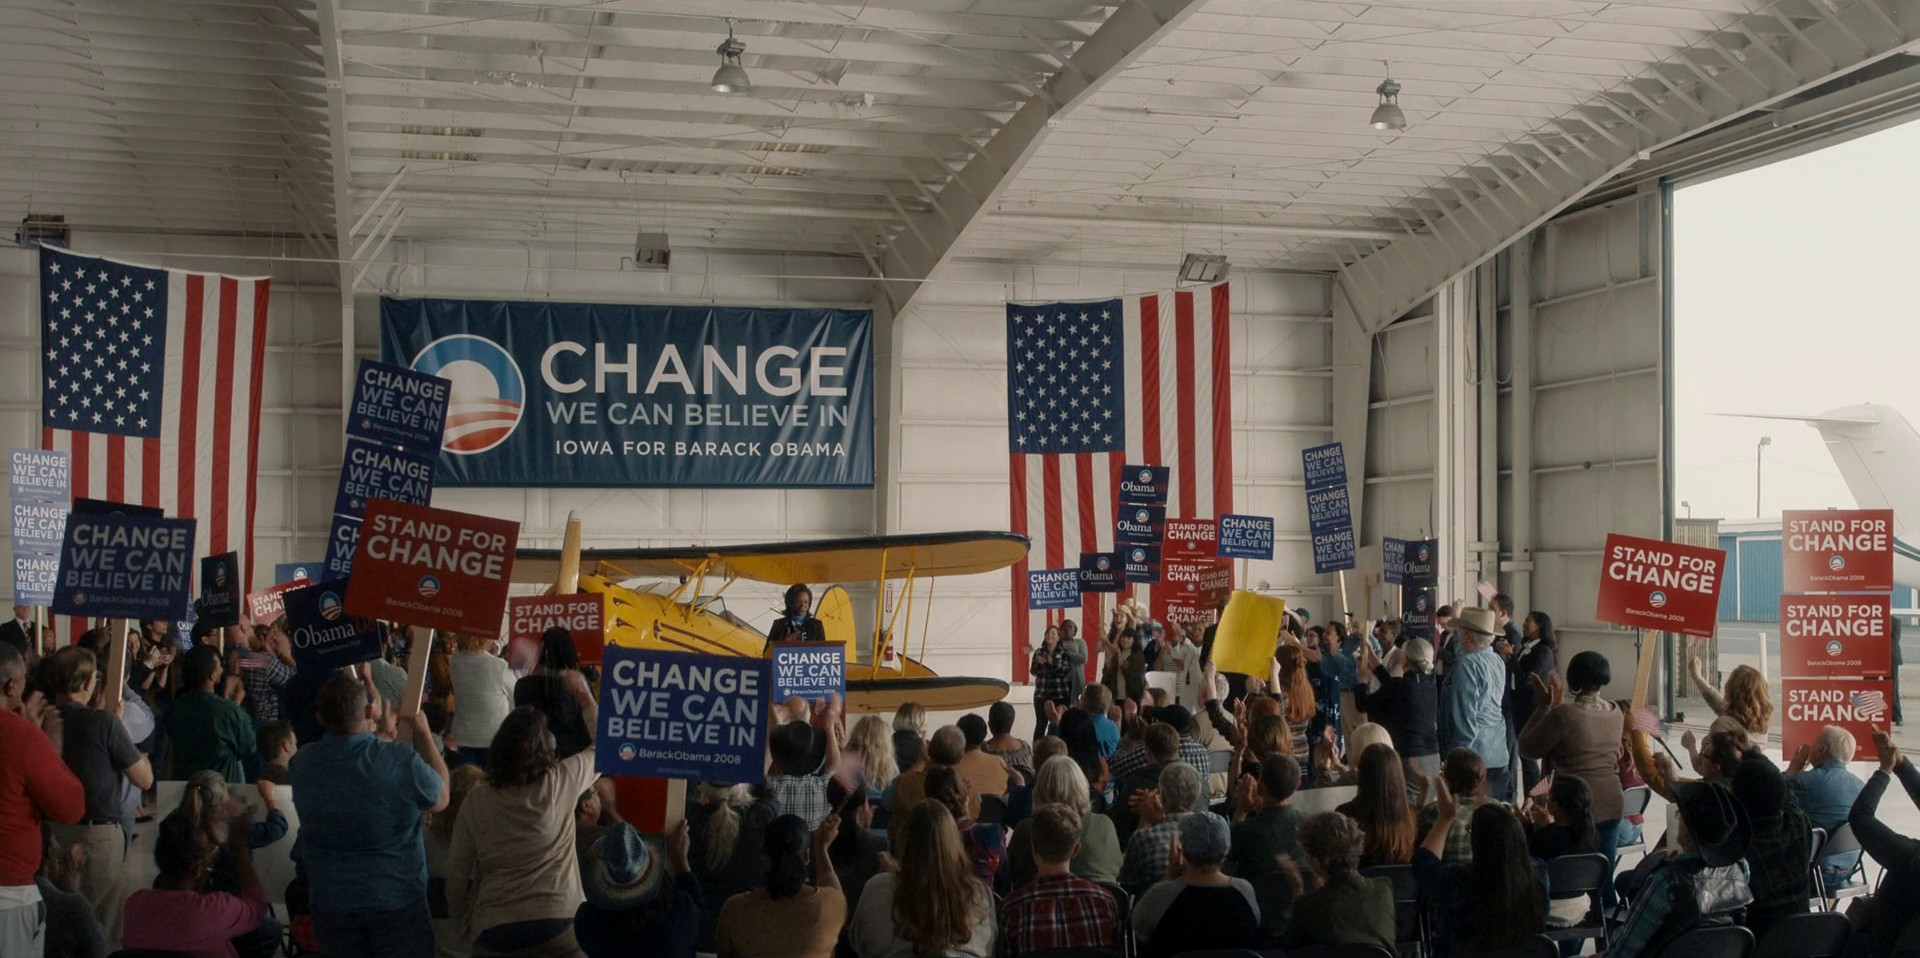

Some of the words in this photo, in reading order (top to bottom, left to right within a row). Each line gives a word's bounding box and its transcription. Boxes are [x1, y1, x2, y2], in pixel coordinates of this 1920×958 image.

[540, 342, 848, 397] CHANGE
[364, 368, 445, 401] CHANGE
[361, 385, 394, 408] WE
[400, 396, 443, 420] CAN
[356, 402, 420, 428] BELIEVE
[424, 418, 440, 432] IN
[546, 402, 598, 425] WE
[608, 402, 674, 426] CAN
[685, 404, 808, 427] BELIEVE
[820, 405, 848, 428] IN
[556, 440, 614, 456] IOWA
[623, 440, 666, 456] FOR
[676, 440, 762, 456] BARACK
[770, 441, 845, 457] OBAMA
[1305, 446, 1341, 461] CHANGE
[13, 452, 66, 468] CHANGE
[351, 448, 430, 481] CHANGE
[1306, 462, 1320, 471] WE
[1324, 457, 1343, 468] CAN
[13, 464, 36, 476] WE
[40, 467, 67, 480] CAN
[1307, 467, 1335, 479] BELIEVE
[13, 475, 54, 488] BELIEVE
[57, 480, 66, 488] IN
[350, 465, 383, 487] WE
[388, 475, 428, 499] CAN
[1121, 481, 1155, 492] Obama
[1310, 489, 1346, 504] CHANGE
[14, 505, 66, 520] CHANGE
[1311, 503, 1326, 513] WE
[1329, 499, 1347, 510] CAN
[1311, 510, 1340, 521] BELIEVE
[14, 517, 34, 528] WE
[39, 518, 66, 530] CAN
[1118, 520, 1152, 532] Obama
[1222, 519, 1271, 530] CHANGE
[1790, 520, 1845, 532] STAND
[1851, 520, 1886, 532] FOR
[14, 528, 54, 539] BELIEVE
[72, 524, 188, 549] CHANGE
[373, 514, 451, 542] STAND
[458, 528, 506, 553] FOR
[1168, 531, 1215, 540] CHANGE
[1222, 528, 1242, 538] WE
[1246, 530, 1271, 540] CAN
[1315, 531, 1352, 545] CHANGE
[1221, 538, 1258, 547] BELIEVE
[1261, 540, 1270, 548] IN
[1316, 544, 1332, 554] WE
[1334, 541, 1353, 551] CAN
[1789, 534, 1887, 551] CHANGE
[71, 547, 116, 570] WE
[125, 551, 185, 574] CAN
[367, 535, 504, 580] CHANGE
[1316, 551, 1346, 562] BELIEVE
[1613, 546, 1674, 566] STAND
[1678, 556, 1716, 574] FOR
[16, 558, 59, 571] CHANG
[1404, 561, 1430, 573] Obama
[16, 571, 35, 582] WE
[66, 570, 154, 591] BELIEVE
[161, 574, 182, 592] IN
[1031, 572, 1076, 582] CHANGE
[1080, 570, 1113, 580] Obama
[1168, 572, 1199, 581] CHAN
[1200, 572, 1217, 580] STAND
[1609, 561, 1715, 594] CHANGE
[16, 582, 55, 592] BELIEVE
[1031, 583, 1050, 591] WE
[1054, 581, 1078, 590] CAN
[1200, 578, 1228, 591] CHANGE
[202, 588, 229, 608] Obama
[385, 597, 440, 615] BarackObama
[442, 607, 463, 618] 2008
[515, 604, 564, 617] STAND
[568, 603, 598, 614] FOR
[1626, 608, 1667, 619] BarackObama
[1787, 605, 1842, 618] STAND
[1848, 605, 1882, 617] FOR
[514, 615, 599, 634] CHANGE
[1786, 619, 1884, 636] CHANGE
[293, 623, 356, 648] Obama
[778, 653, 840, 664] CHANGE
[612, 660, 760, 696] CHANGE
[778, 665, 804, 677] WE
[808, 665, 841, 677] CAN
[778, 677, 826, 687] BELIEVE
[829, 677, 840, 686] IN
[1789, 690, 1844, 702] STAND
[611, 688, 671, 719] WE
[682, 694, 758, 725] CAN
[608, 717, 720, 745] BELIEVE
[729, 726, 756, 747] IN
[639, 748, 711, 762] BarackObama
[714, 753, 741, 764] 2008
